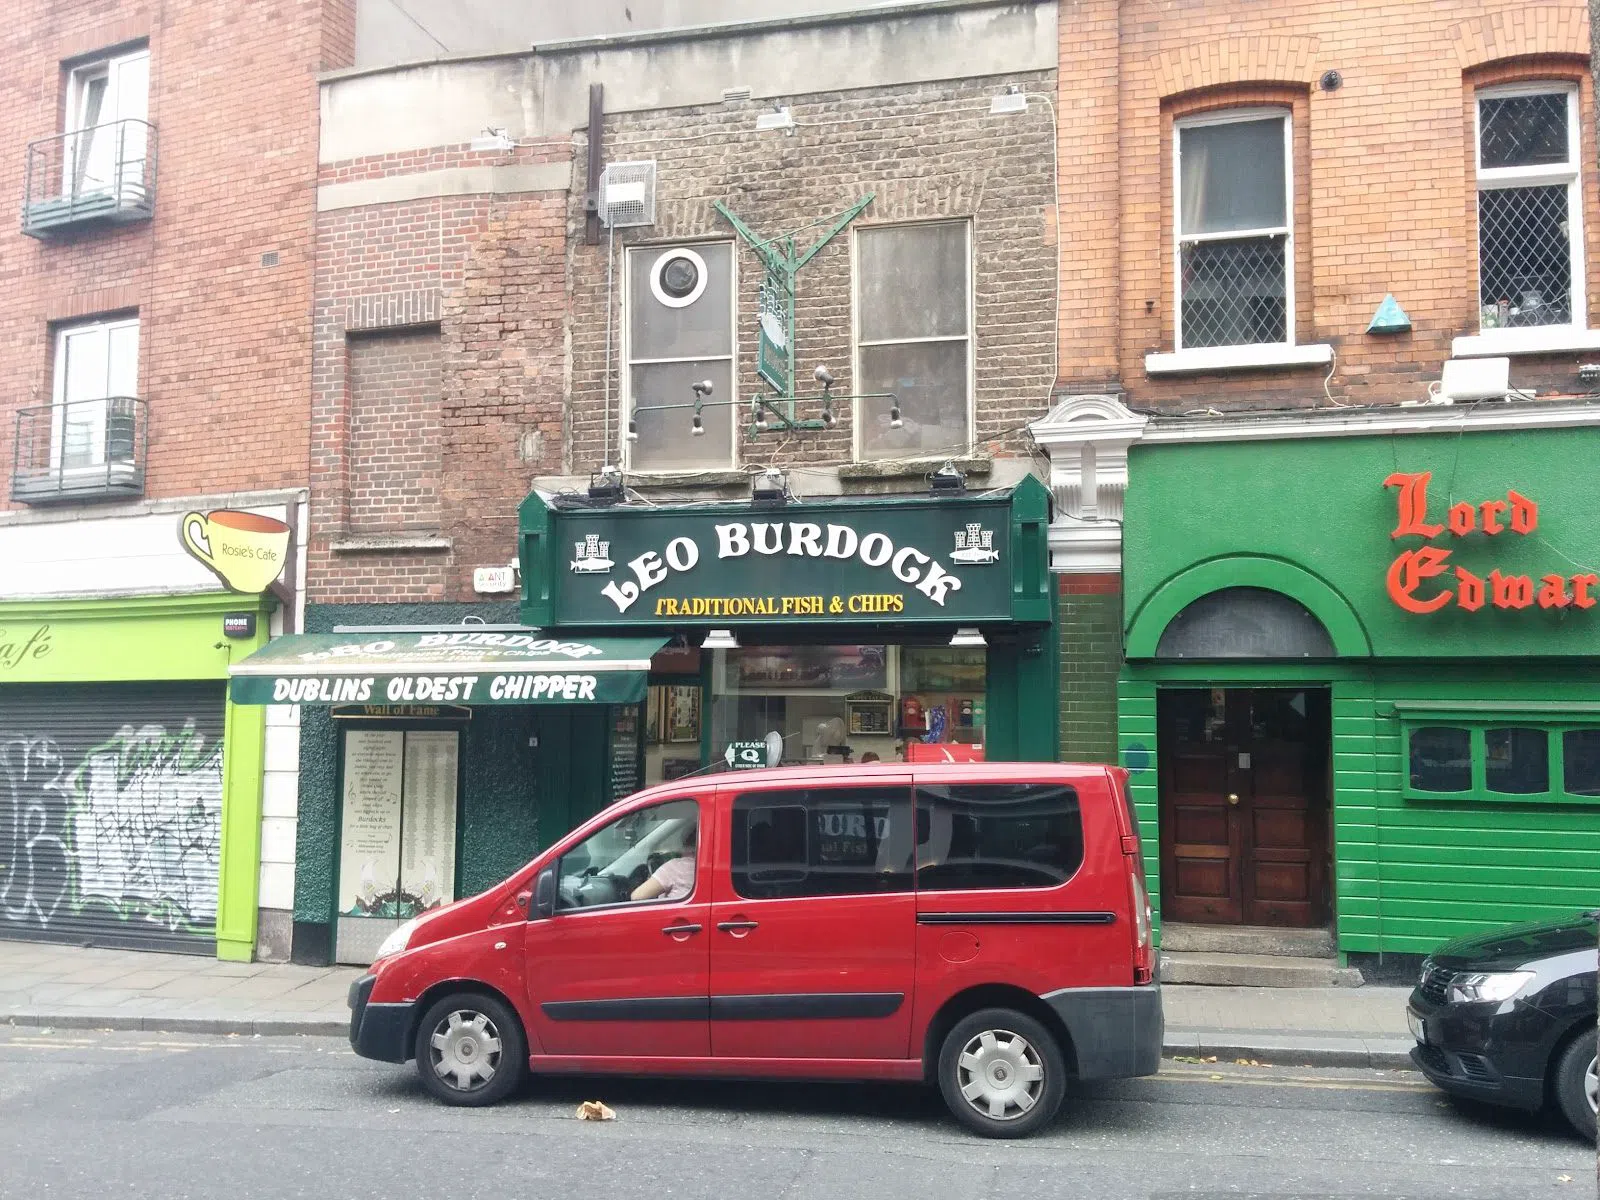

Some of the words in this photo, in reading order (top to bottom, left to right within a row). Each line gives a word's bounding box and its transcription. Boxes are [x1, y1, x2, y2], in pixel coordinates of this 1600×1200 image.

[1382, 471, 1538, 540] Lord
[222, 543, 254, 559] Rosie's
[600, 536, 699, 613] LEO
[715, 521, 962, 606] BURDOCK
[1386, 546, 1599, 614] Edwar
[655, 597, 779, 616] TRADITIONAL
[782, 595, 824, 615] FISH
[829, 595, 844, 613] &
[848, 594, 904, 613] CHIPS
[225, 618, 248, 626] PHONE
[0, 624, 53, 669] afé
[413, 633, 602, 658] BURDOCK
[273, 677, 374, 702] DUBLINS
[387, 676, 478, 701] OLDEST
[489, 674, 598, 701] CHIPPER
[364, 704, 390, 715] Wall
[393, 704, 405, 715] of
[741, 749, 760, 763] Q
